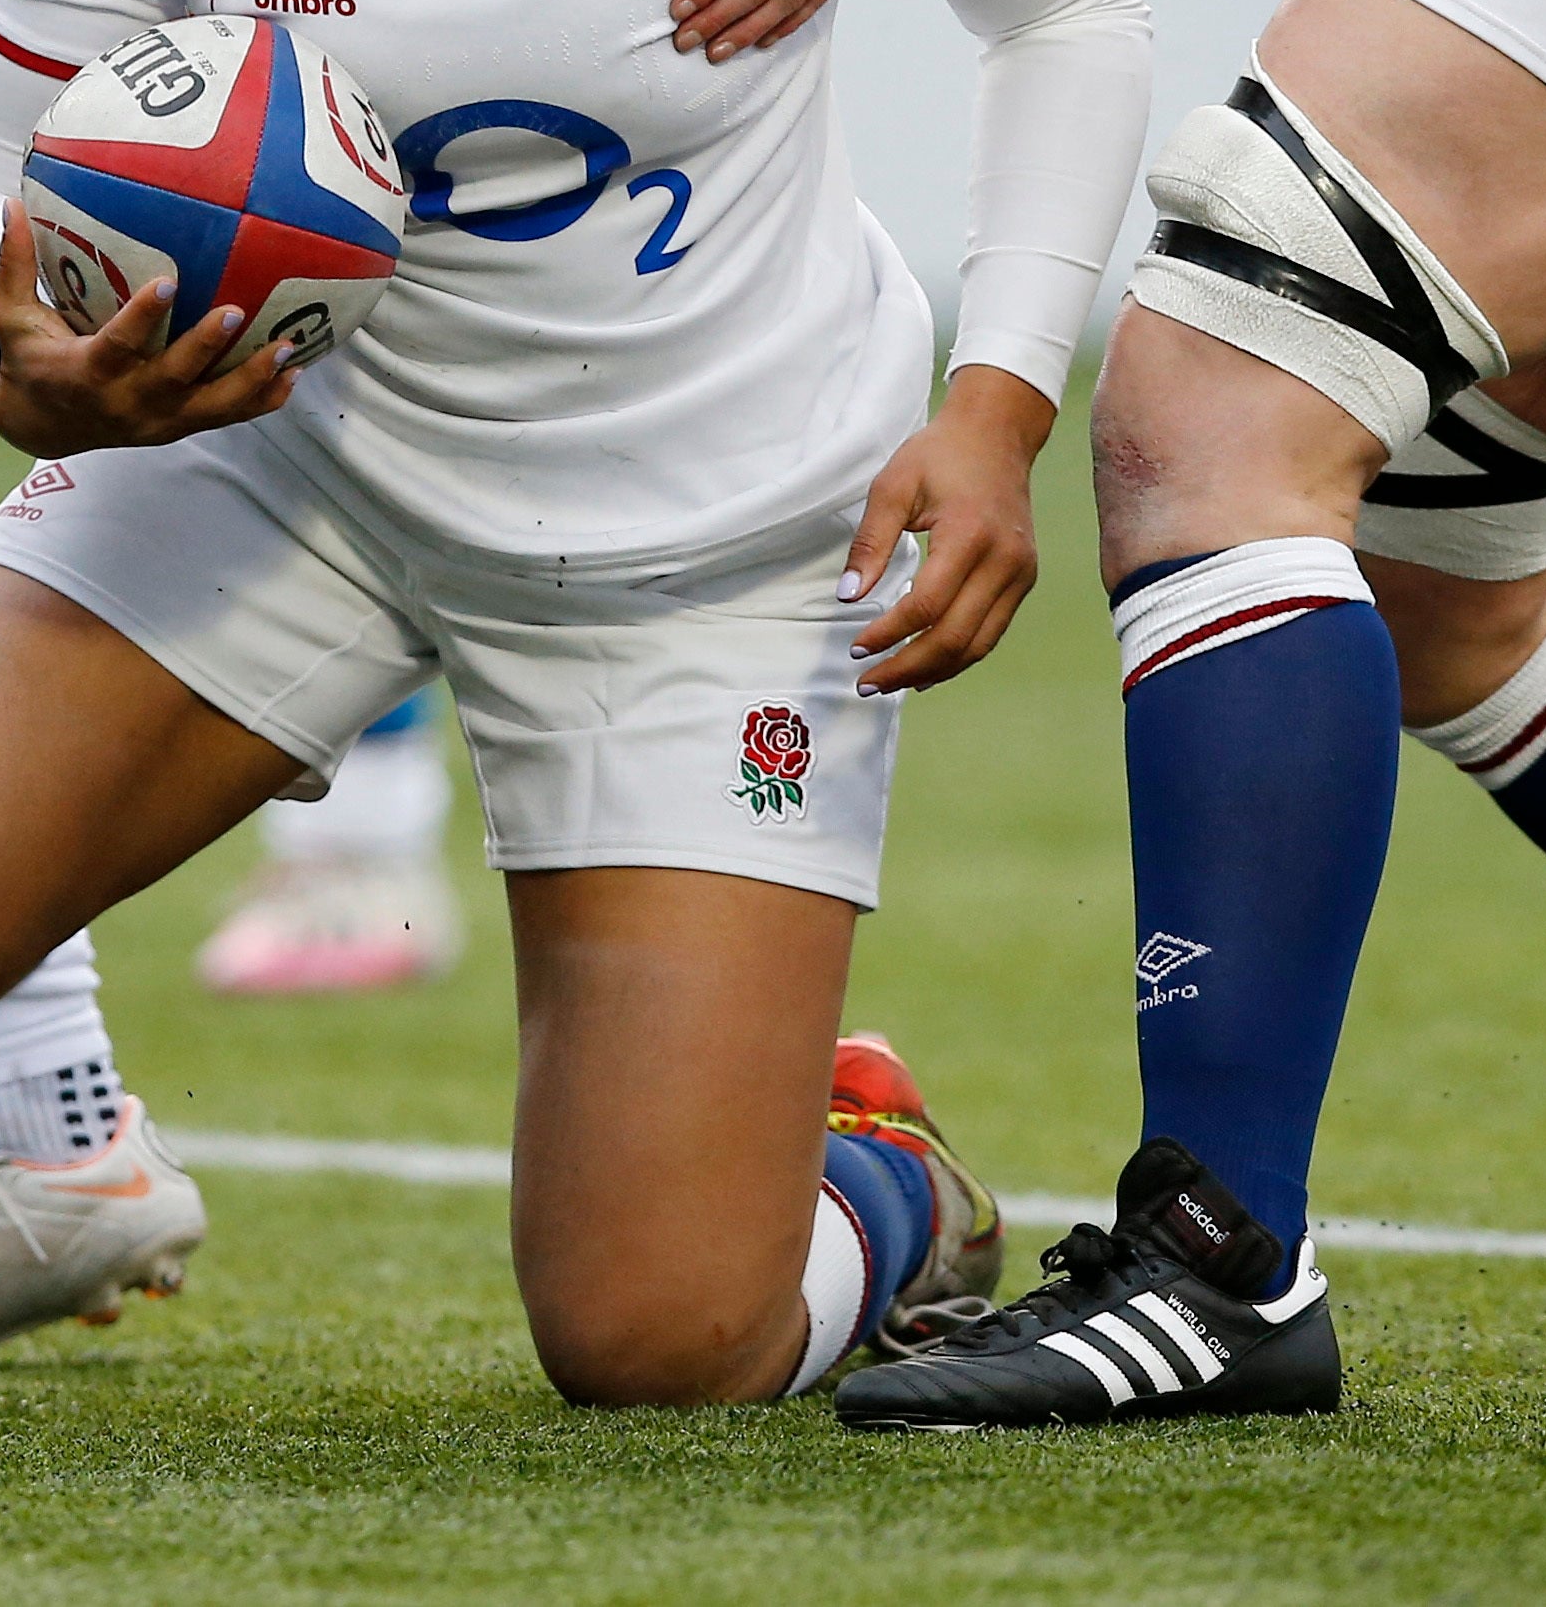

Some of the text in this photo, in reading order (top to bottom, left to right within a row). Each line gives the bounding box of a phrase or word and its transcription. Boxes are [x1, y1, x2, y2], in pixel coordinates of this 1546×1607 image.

[392, 99, 698, 276] O2
[1135, 984, 1200, 1013] mbro
[1177, 1192, 1229, 1245] adidas
[1166, 1293, 1231, 1361] WORLD CUP
